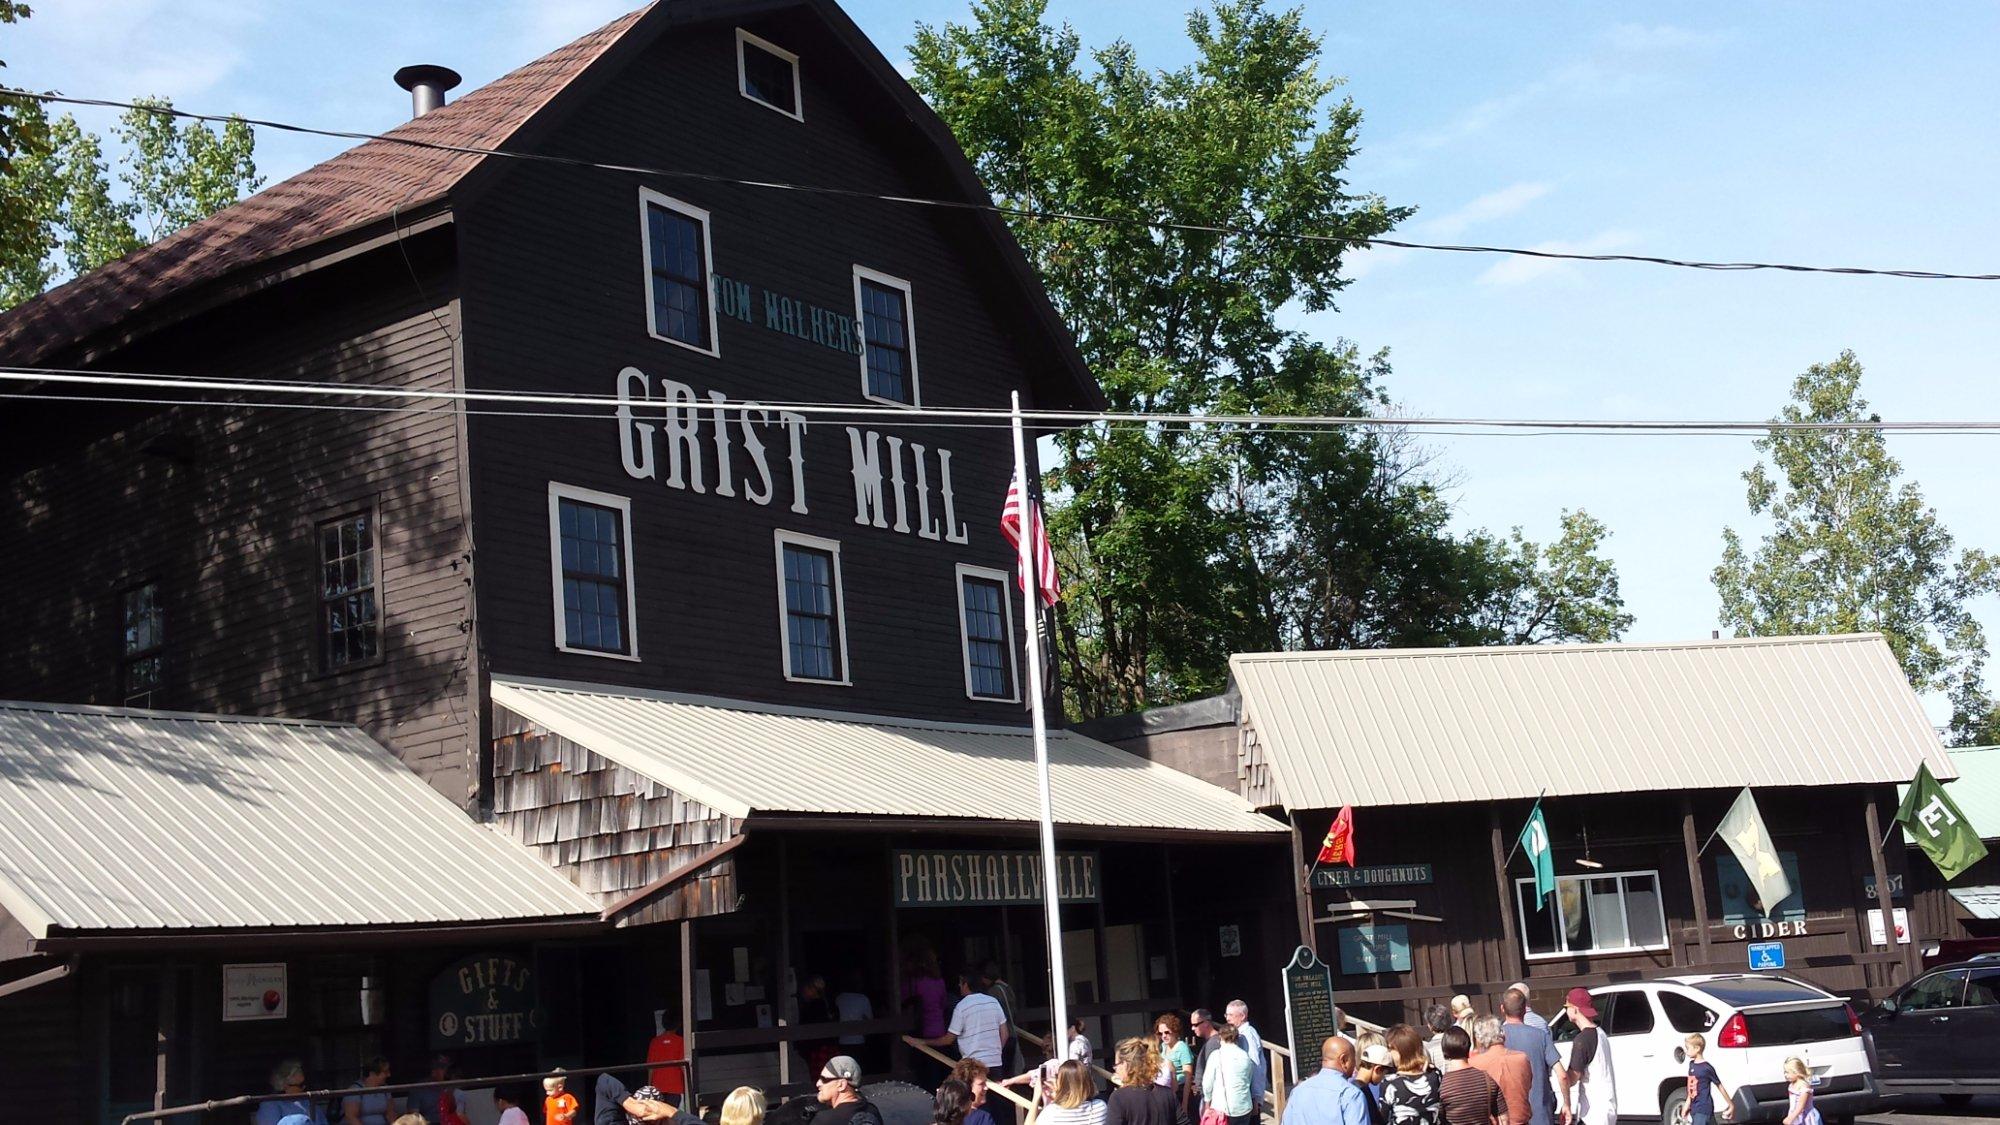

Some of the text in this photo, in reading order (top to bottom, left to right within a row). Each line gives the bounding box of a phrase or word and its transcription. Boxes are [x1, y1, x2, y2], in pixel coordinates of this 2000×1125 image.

[711, 273, 864, 356] TOM WALKERS
[615, 366, 969, 545] GRIST MILL
[899, 854, 1095, 902] PARSHALLVLLE
[1317, 867, 1427, 886] CIDER & DOUGHNUTS
[1865, 875, 1903, 899] 807
[1734, 921, 1807, 939] CIDER
[458, 958, 531, 995] GIFTS
[487, 988, 500, 1010] &
[464, 1012, 524, 1043] STUFF
